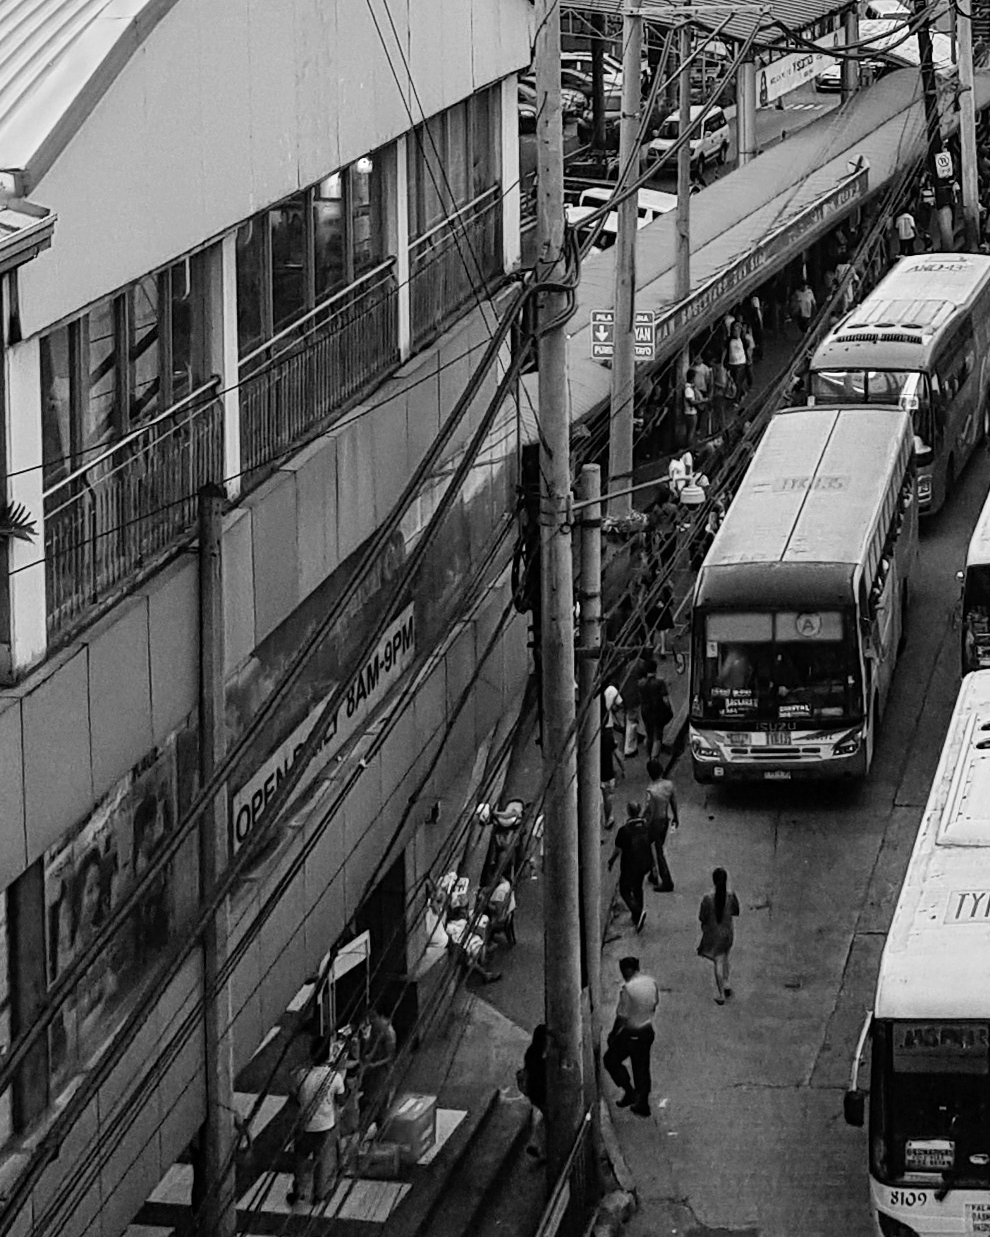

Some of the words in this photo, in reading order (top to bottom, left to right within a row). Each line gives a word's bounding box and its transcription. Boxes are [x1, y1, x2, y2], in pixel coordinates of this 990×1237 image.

[802, 619, 815, 633] A
[346, 615, 414, 719] 8AM-9PM
[756, 722, 797, 732] ISUZU
[890, 1190, 928, 1207] 8109
